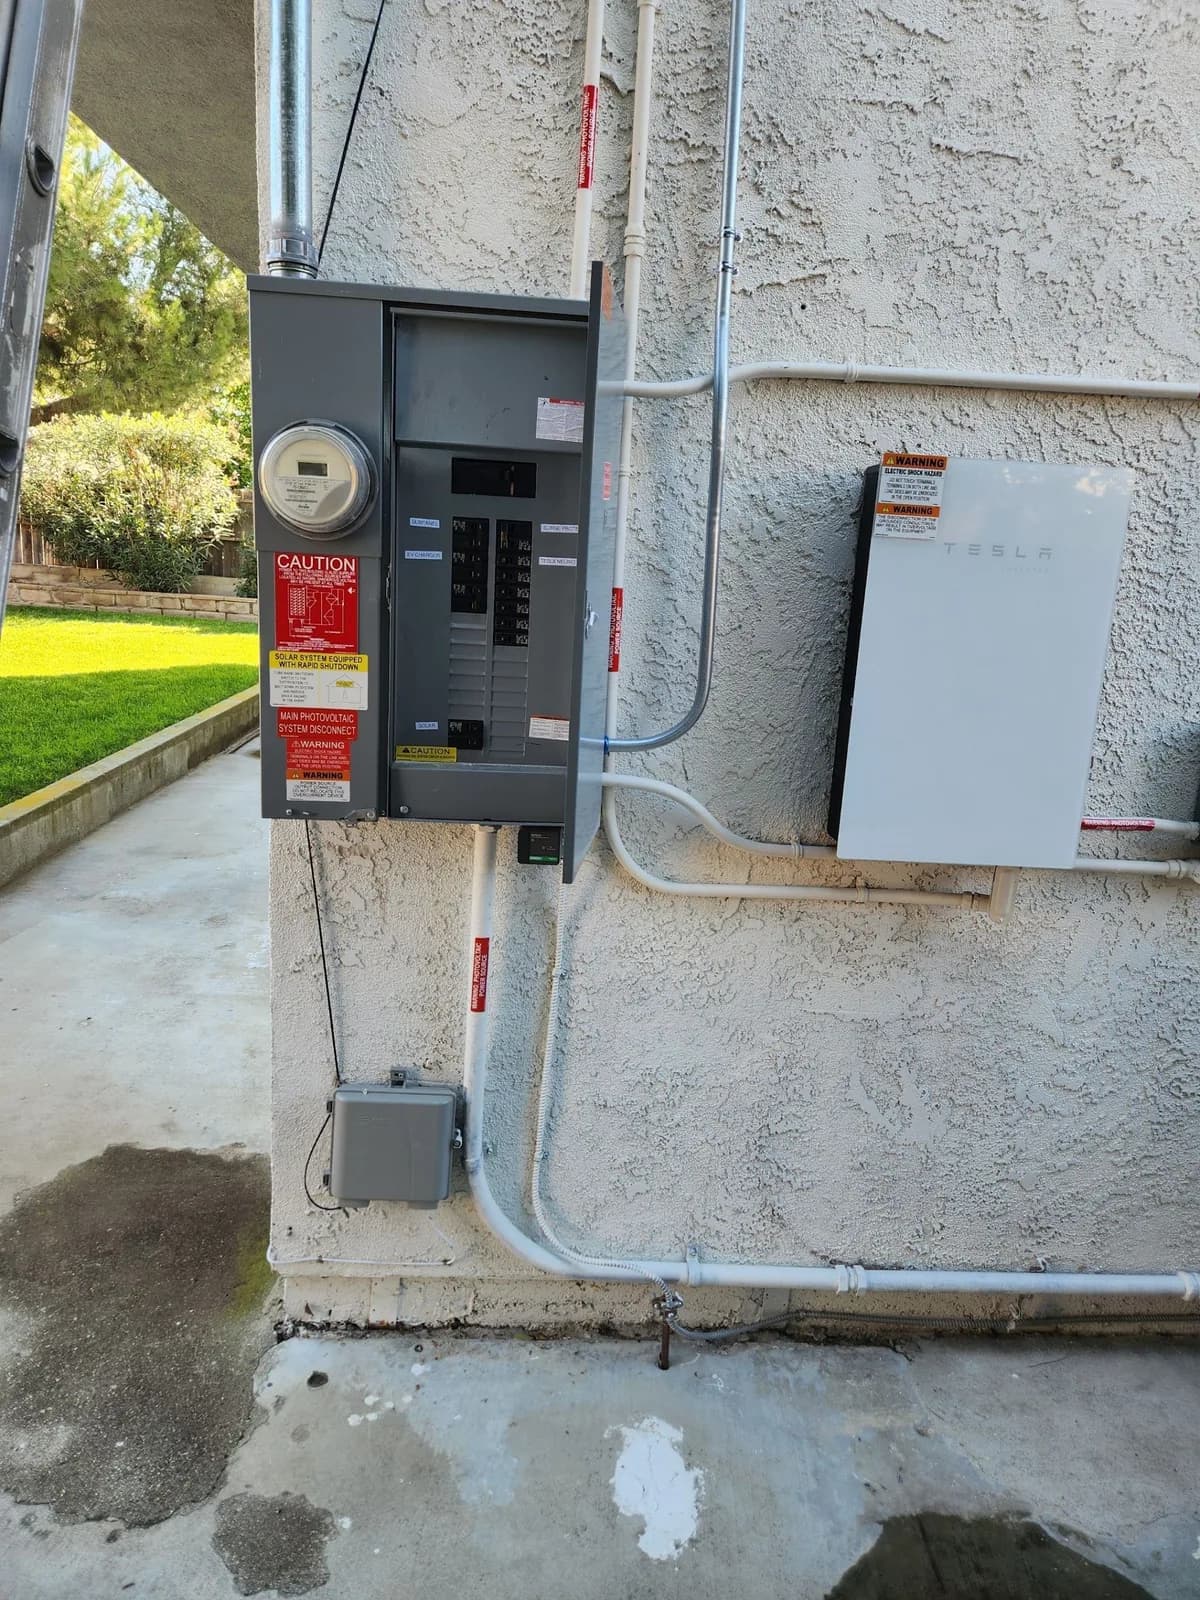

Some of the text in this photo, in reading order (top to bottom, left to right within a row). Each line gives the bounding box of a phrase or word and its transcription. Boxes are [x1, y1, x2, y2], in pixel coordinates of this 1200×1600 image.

[582, 92, 590, 147] PHOTOVOLTAIC
[895, 456, 944, 468] WARNING
[893, 505, 932, 515] WARNING
[944, 542, 1052, 560] TESLA
[278, 554, 355, 571] CAUTION
[280, 712, 354, 723] MAIN PHOTOVOLTAIC
[279, 723, 356, 735] SYSTEM DISCONNECT
[300, 741, 345, 749] WARNING
